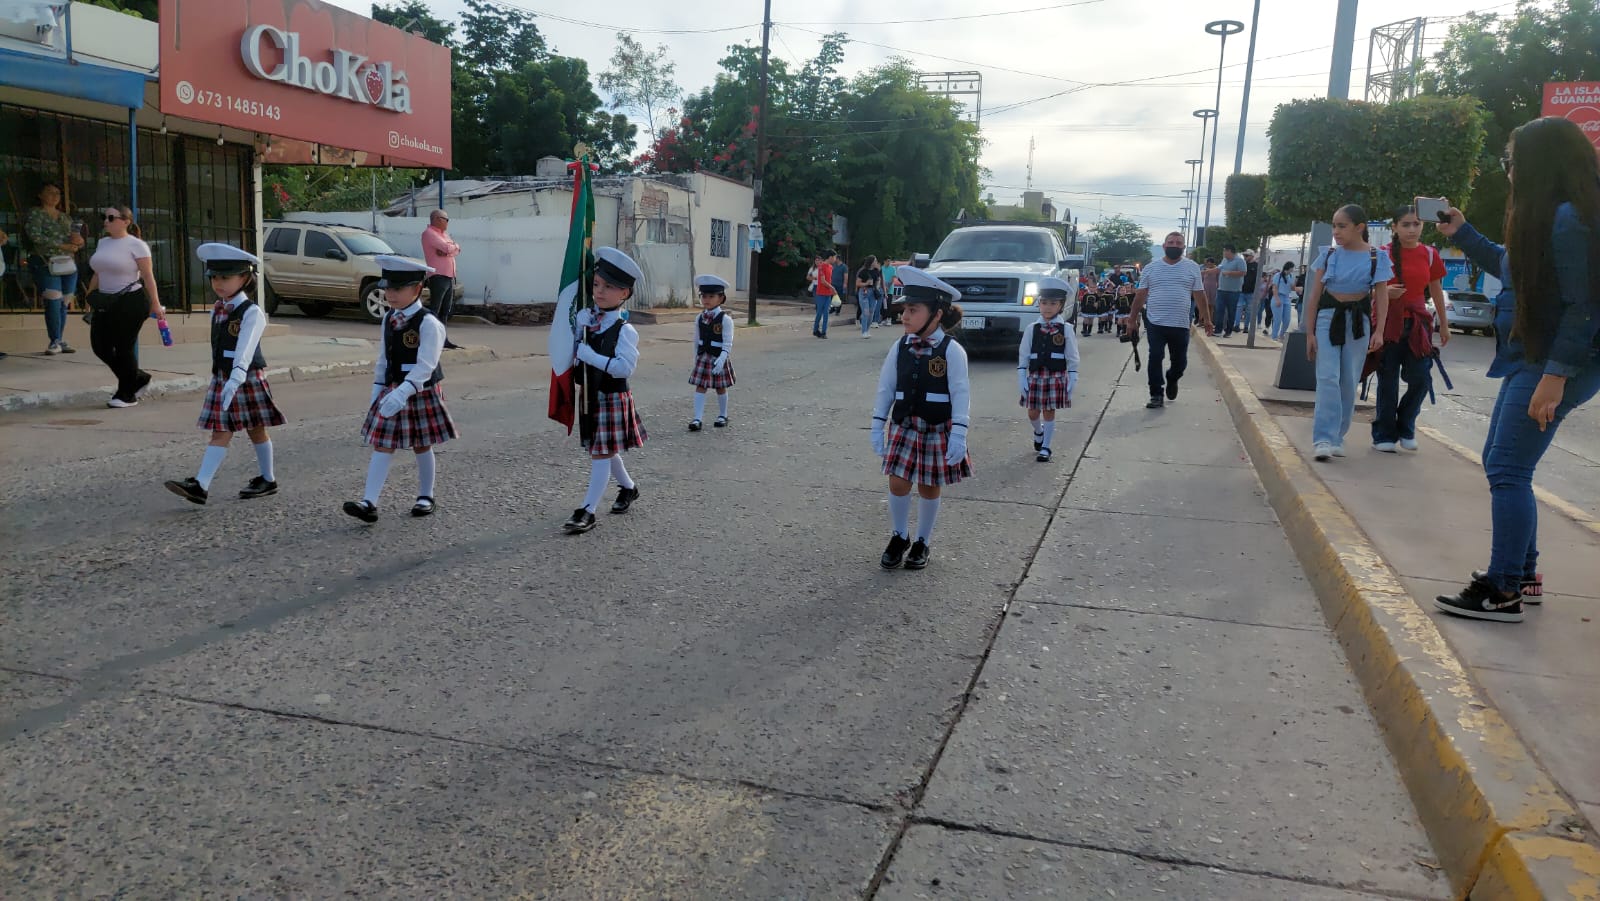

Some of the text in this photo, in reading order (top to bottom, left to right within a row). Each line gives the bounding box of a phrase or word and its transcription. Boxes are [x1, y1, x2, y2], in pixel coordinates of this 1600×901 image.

[1555, 87, 1571, 95] LA
[197, 89, 281, 121] 673 1485143
[400, 134, 443, 155] chokola.mx
